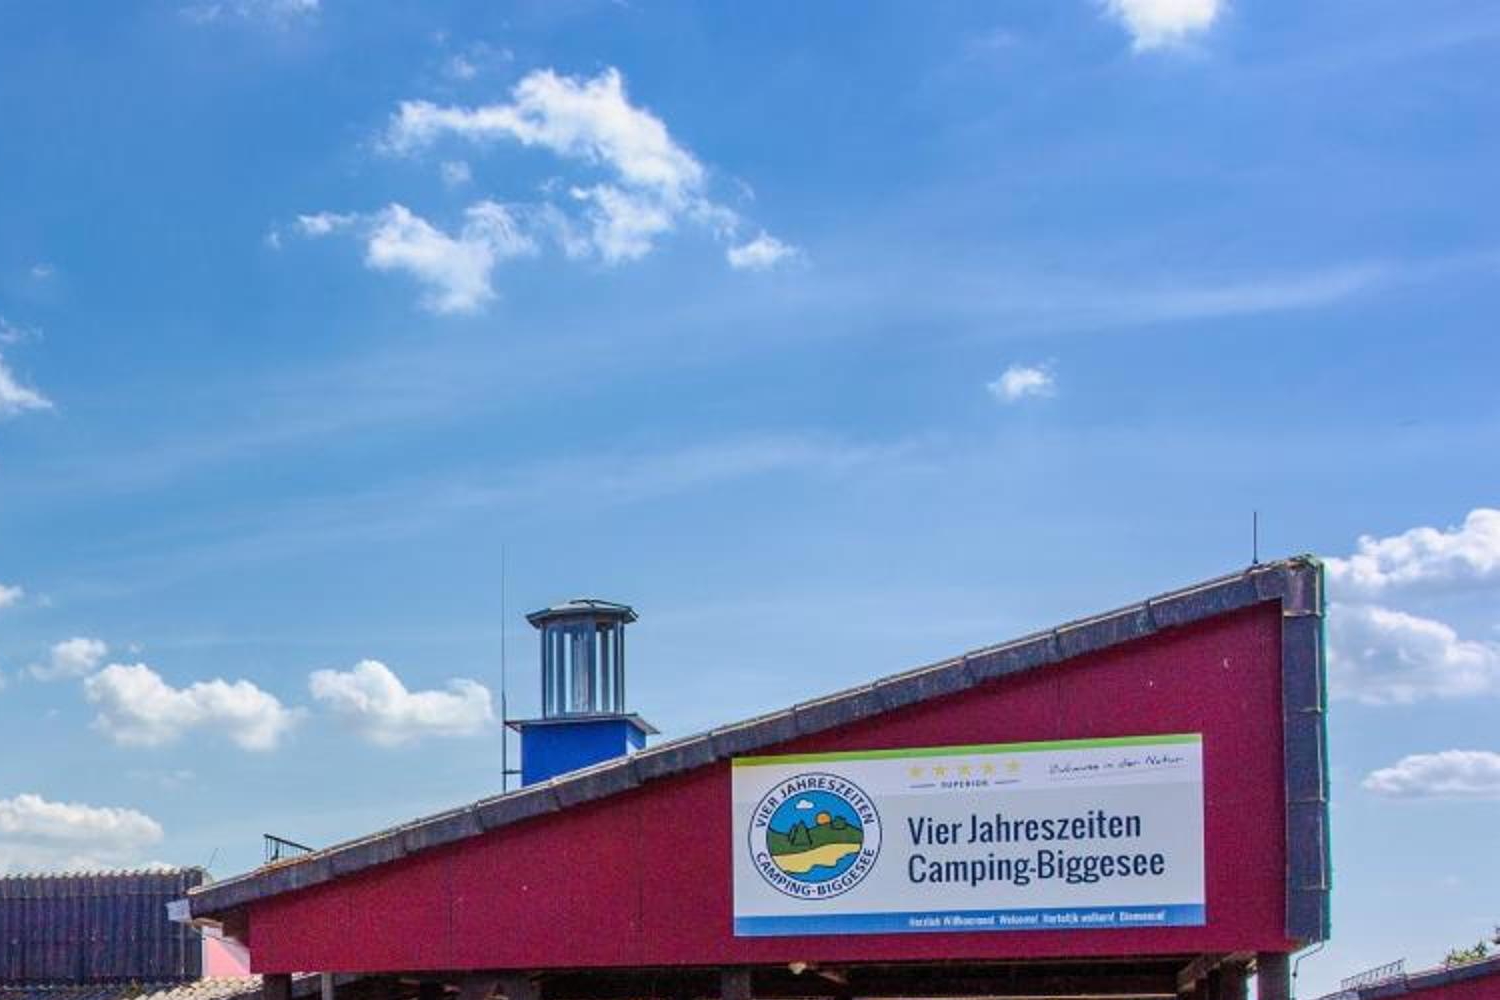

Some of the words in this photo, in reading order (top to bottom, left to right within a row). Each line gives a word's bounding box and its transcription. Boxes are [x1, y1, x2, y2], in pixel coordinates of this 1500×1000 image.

[756, 797, 778, 829] VIER
[780, 777, 875, 825] JAHRESZEITEN
[907, 816, 963, 846] Vier
[967, 809, 1142, 845] Jahreszeiten
[756, 848, 875, 896] CAMPING-BIGGESEE
[907, 849, 1166, 888] Camping-Biggesee
